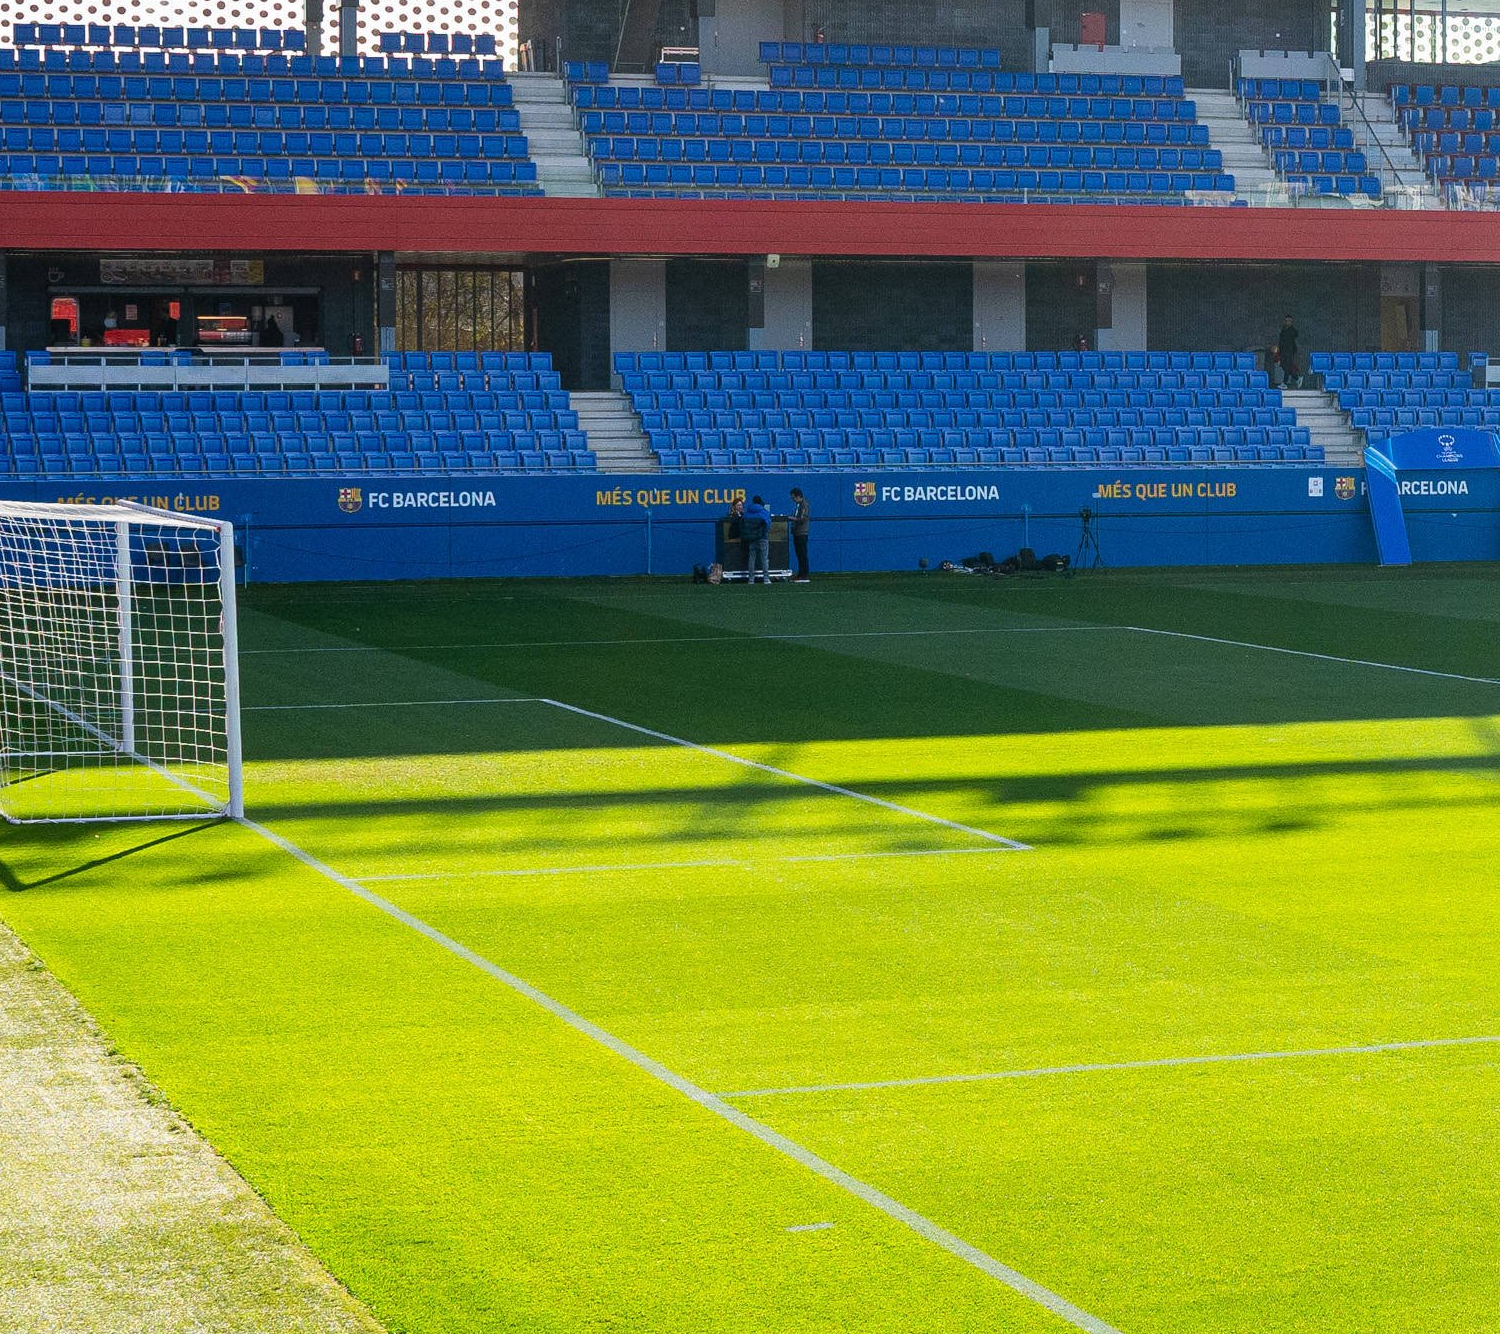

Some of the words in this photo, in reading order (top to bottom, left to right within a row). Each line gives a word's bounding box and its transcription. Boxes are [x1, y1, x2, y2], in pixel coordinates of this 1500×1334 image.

[596, 486, 633, 505] MÉS
[637, 489, 670, 508] QUE
[675, 489, 700, 504] UN
[882, 486, 901, 501] FC
[904, 485, 1000, 501] BARCELONA
[1099, 480, 1132, 499] MÉS
[1136, 483, 1167, 501] QUE
[1171, 483, 1193, 498] UN
[1197, 482, 1237, 497] CLUB
[174, 495, 220, 511] CLUB
[368, 492, 390, 508] FC
[393, 491, 496, 508] BARCELONA
